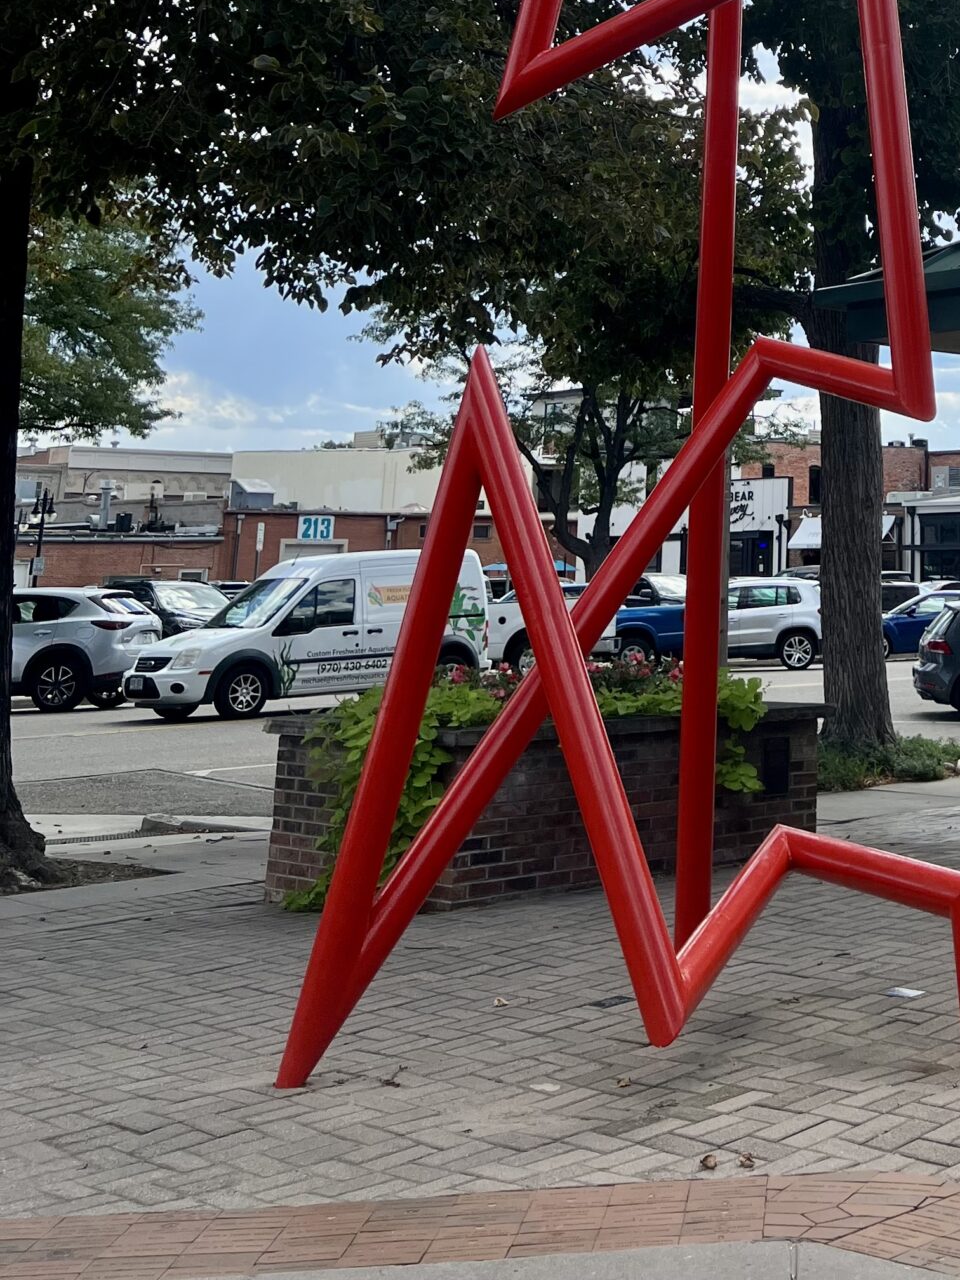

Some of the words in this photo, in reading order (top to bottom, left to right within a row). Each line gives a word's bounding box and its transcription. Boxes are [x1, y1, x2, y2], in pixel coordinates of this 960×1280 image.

[301, 517, 332, 539] 213
[306, 650, 332, 658] Custom
[332, 647, 367, 656] Freshwater
[317, 662, 342, 675] (970)
[343, 659, 388, 671] 430-6402
